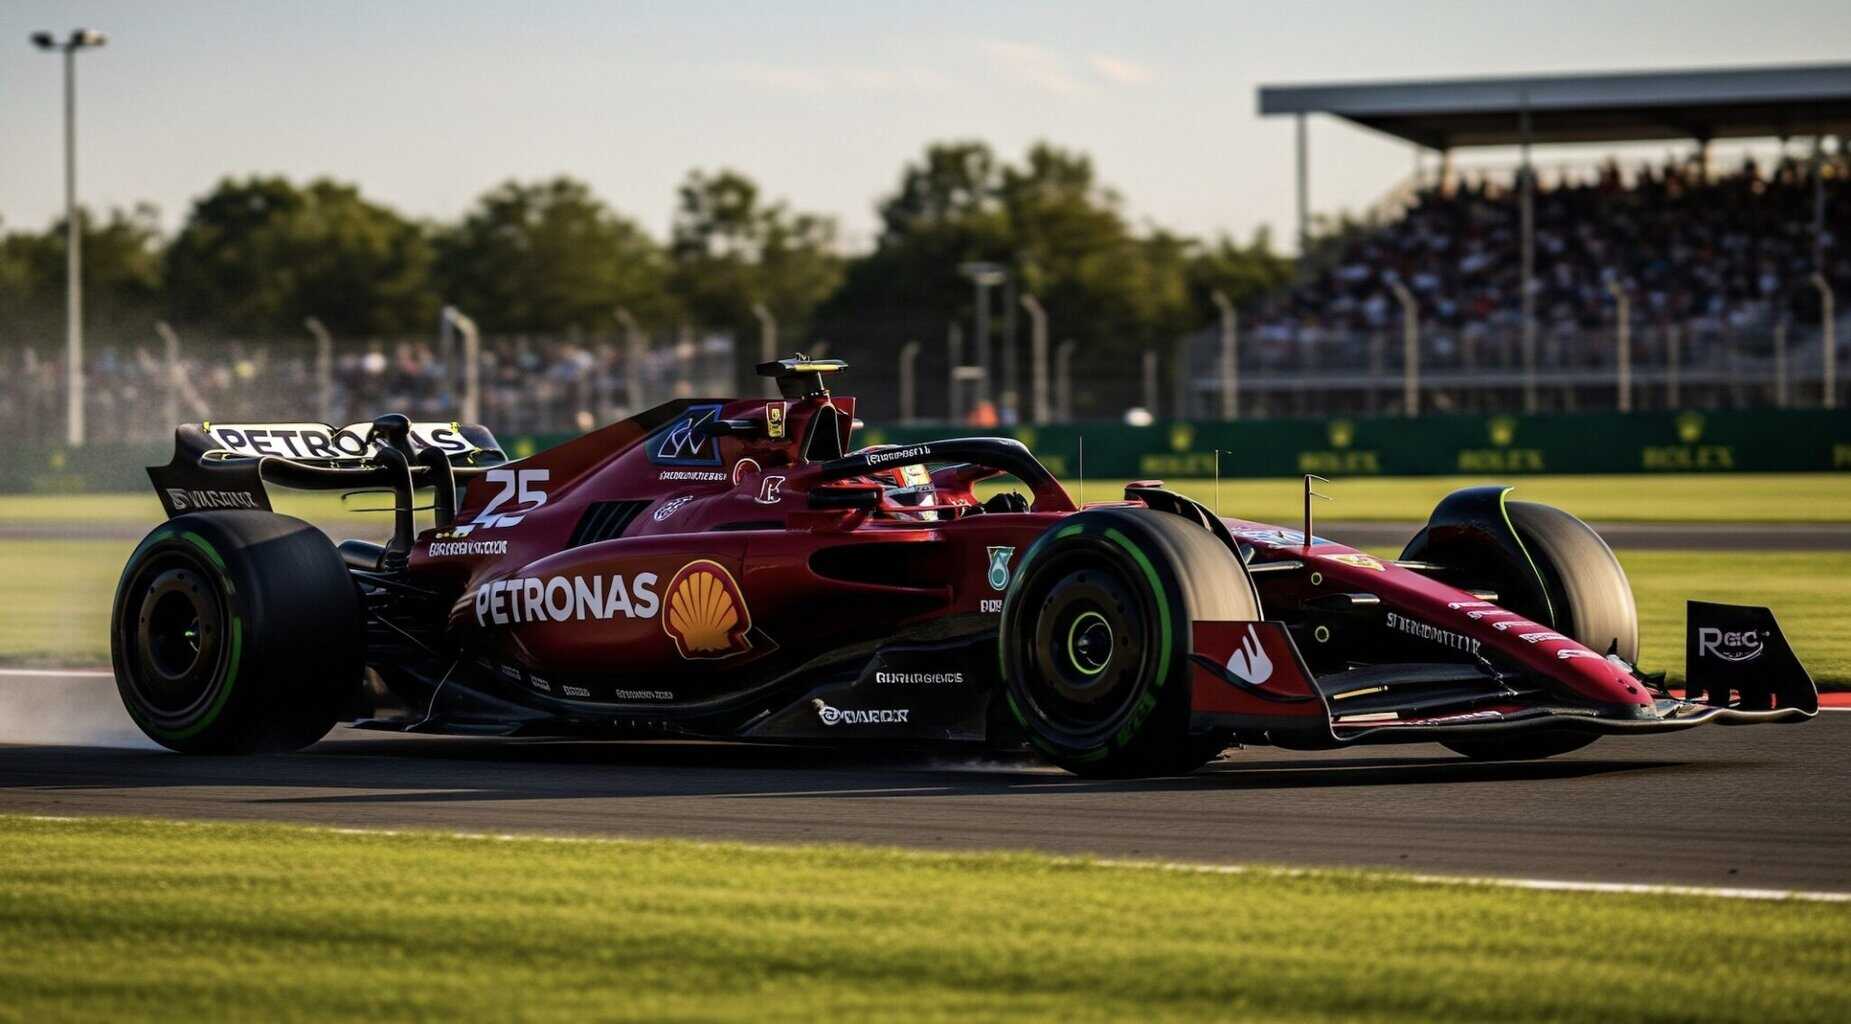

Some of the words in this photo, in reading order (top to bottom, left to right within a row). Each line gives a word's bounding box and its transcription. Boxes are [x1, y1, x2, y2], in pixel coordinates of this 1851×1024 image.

[217, 428, 466, 457] PETROS
[471, 469, 550, 530] 25
[475, 572, 660, 627] PETRONAS
